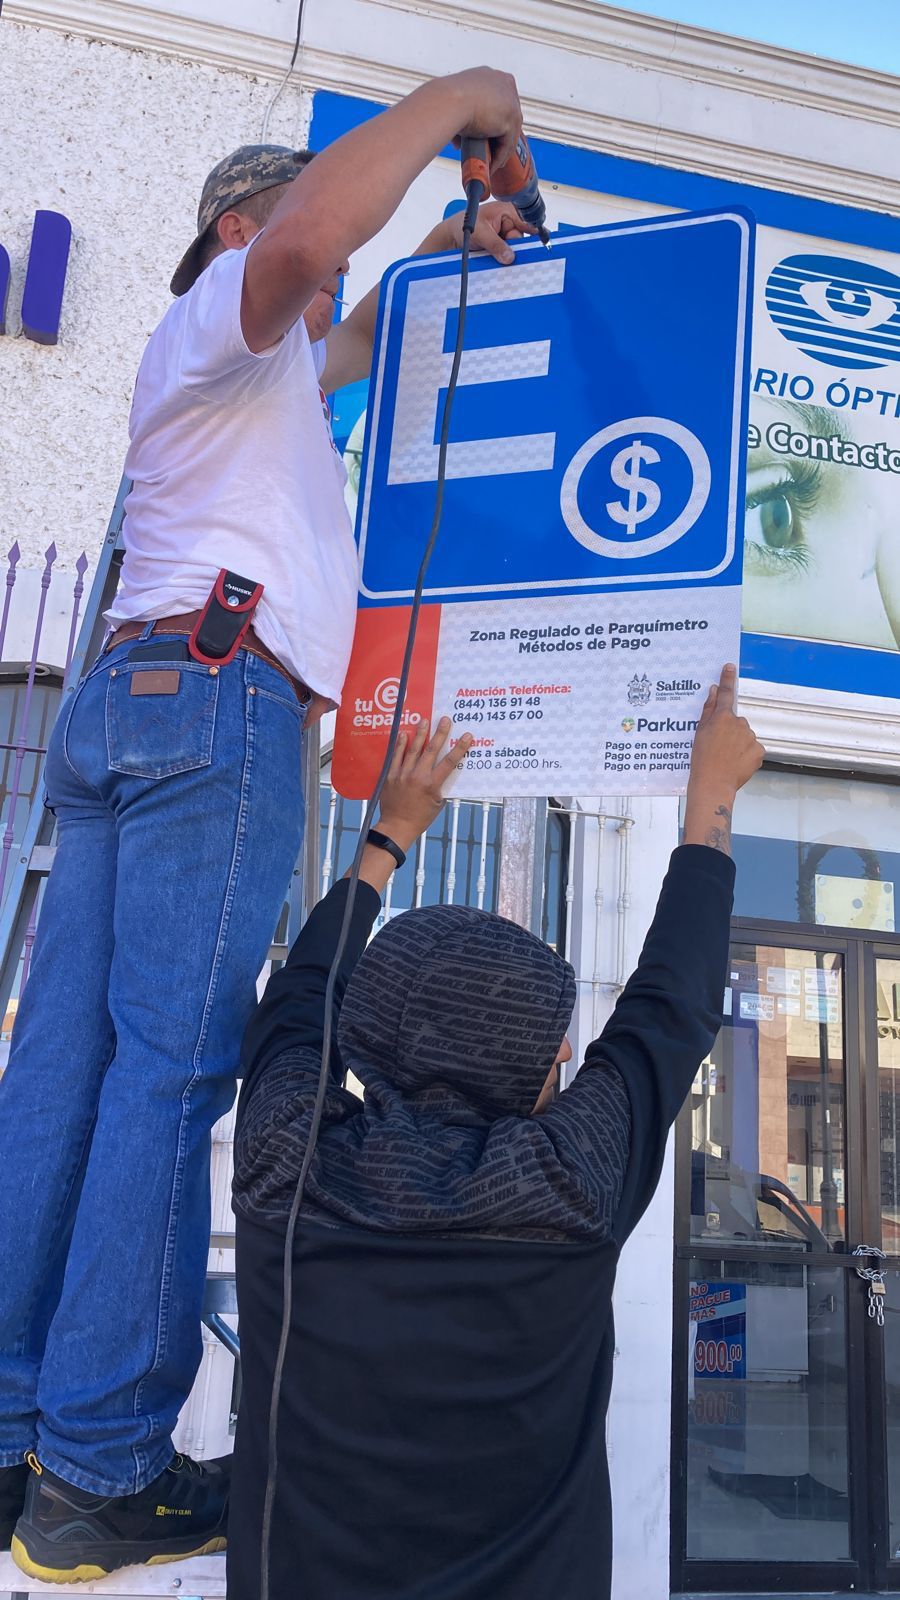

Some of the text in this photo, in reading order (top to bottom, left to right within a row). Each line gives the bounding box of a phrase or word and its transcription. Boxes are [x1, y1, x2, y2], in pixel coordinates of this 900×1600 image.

[387, 258, 566, 486] E
[749, 367, 814, 401] RIO
[469, 619, 709, 642] Zona Regulado de Parquímetro
[518, 637, 651, 653] Métodos de Pago
[456, 684, 572, 697] Atención Telefónica:
[656, 679, 701, 691] Saltillo
[354, 698, 373, 713] tu
[454, 696, 541, 710] (844) 136 91 48
[353, 709, 422, 729] espaio
[452, 710, 544, 723] (844) 143 67 00
[449, 737, 495, 748] Hario:
[605, 741, 632, 751] Pago
[634, 741, 648, 749] en
[494, 747, 537, 758] sábado
[604, 751, 631, 761] Pago
[633, 752, 647, 760] en
[466, 760, 492, 770] 8:00
[504, 759, 539, 769] 20:00
[541, 758, 563, 769] hrs.
[604, 762, 631, 772] Pago
[633, 763, 646, 771] en
[689, 1284, 708, 1297] NO
[690, 1290, 731, 1310] PAGUE
[690, 1307, 716, 1321] MAS
